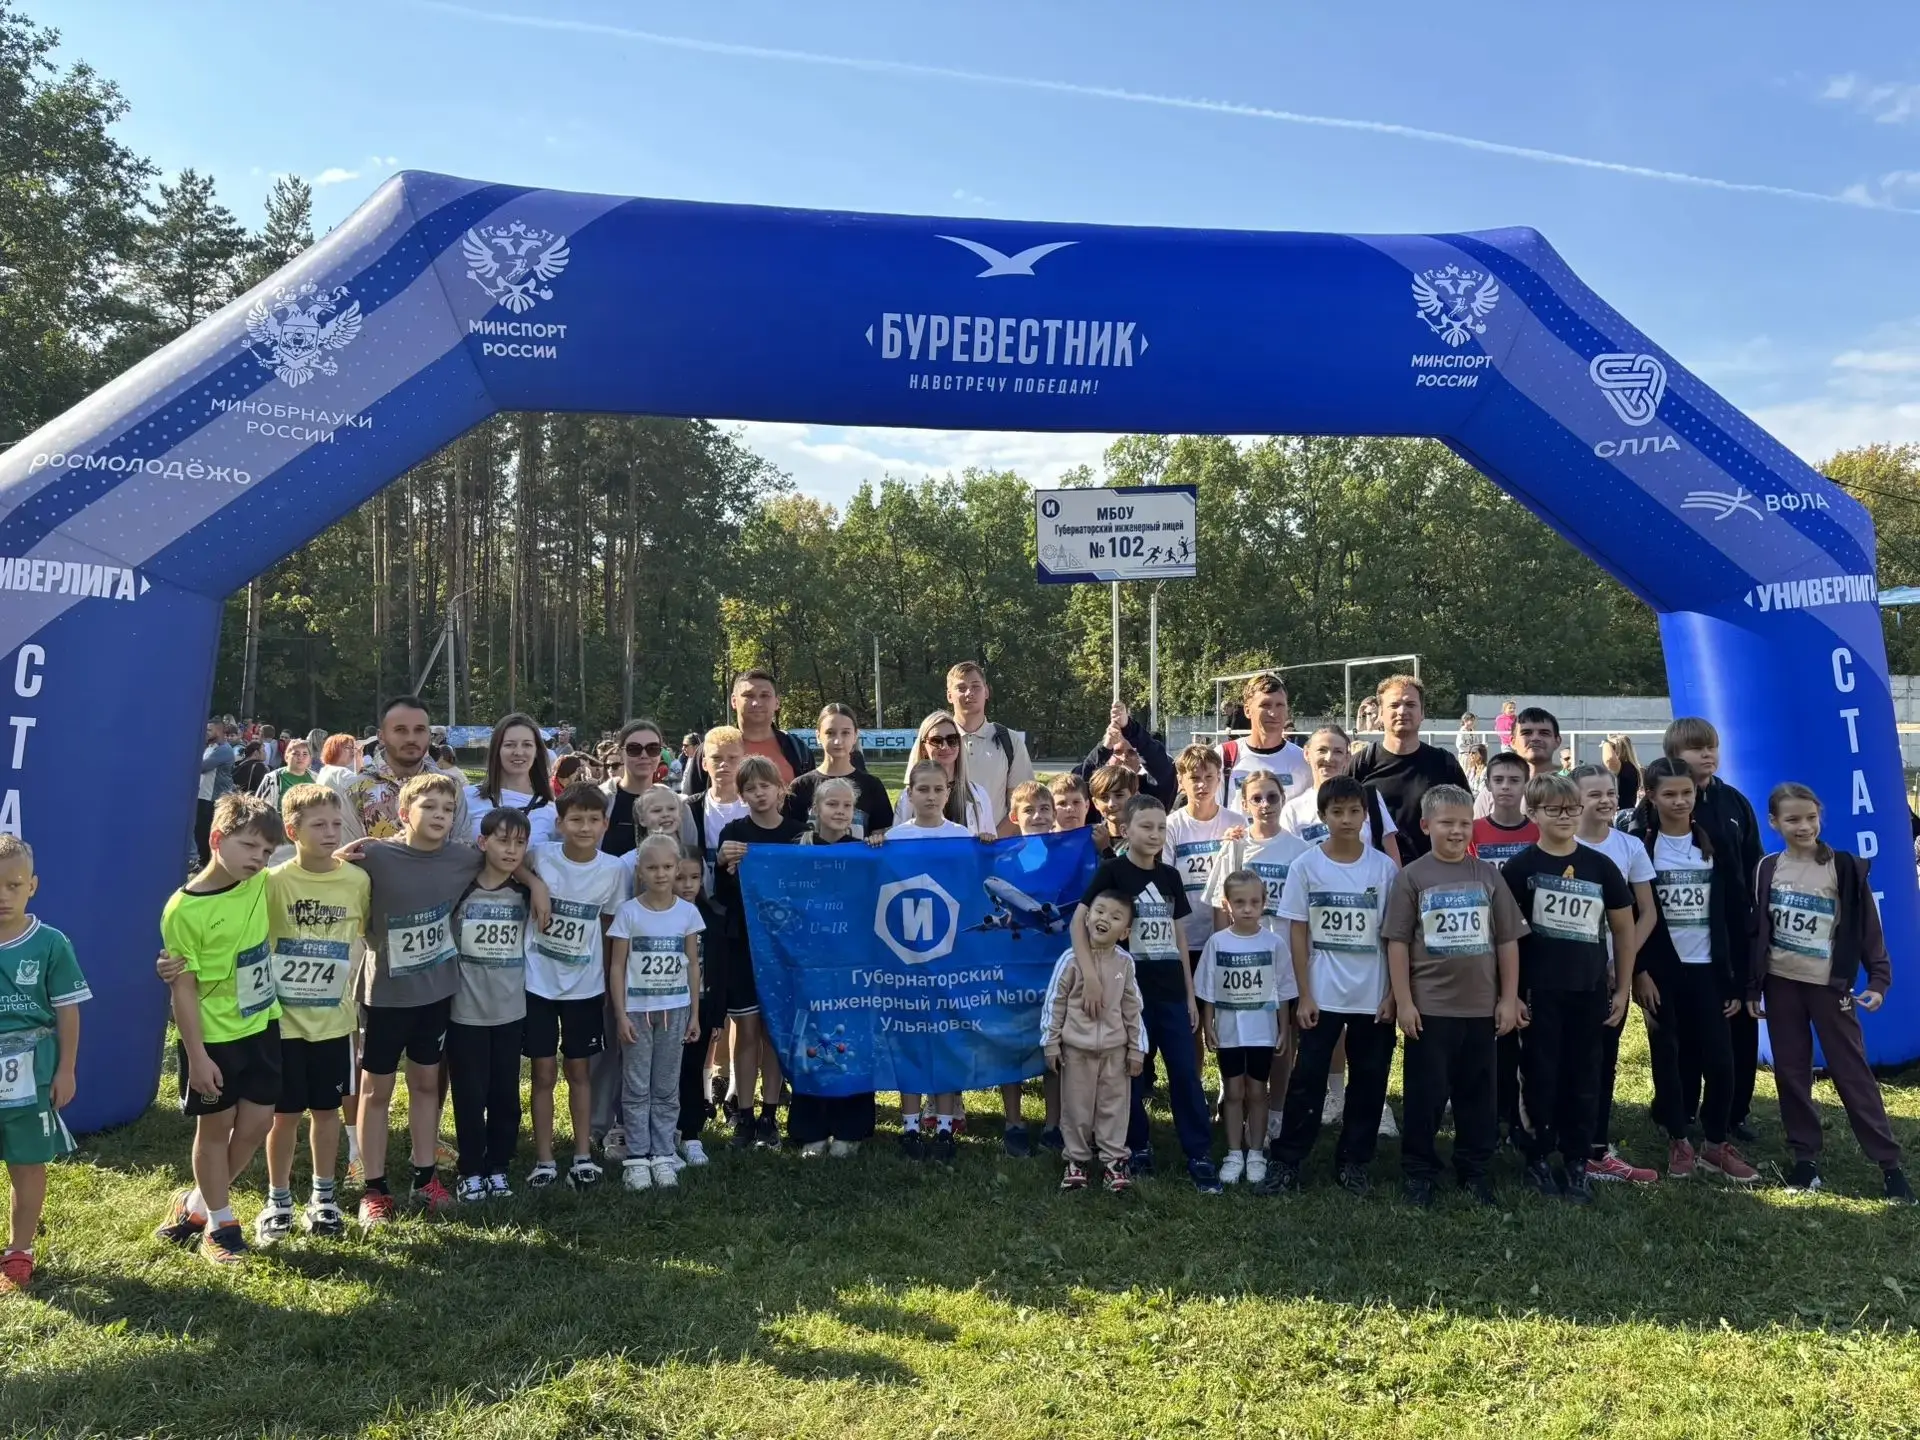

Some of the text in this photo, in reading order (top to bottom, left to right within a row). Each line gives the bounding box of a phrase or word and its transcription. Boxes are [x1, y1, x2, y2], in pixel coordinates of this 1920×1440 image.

[469, 319, 567, 340] МИНСПОРТ
[881, 312, 1136, 367] БУРЕВЕСТНИК
[482, 342, 557, 359] РОССИИ
[1411, 354, 1492, 369] МИНСПОРТ
[910, 374, 1099, 394] НАВСТРЕЧУ ПОБЕДАМ!
[1416, 374, 1478, 388] РОССИИ
[211, 399, 372, 429] МИНОБРНАУКИ
[247, 421, 334, 443] РОССИИ
[28, 452, 251, 485] росмолодёжь
[1765, 492, 1830, 512] ВФЛА
[1097, 506, 1134, 521] МБОУ
[1055, 520, 1184, 537] Губернаторский инженерный лицей
[1090, 536, 1144, 559] № 102
[1756, 575, 1877, 612] УНИВЕРЛИГА
[875, 736, 905, 747] ВСЯ
[1544, 893, 1592, 919] 2107
[1659, 887, 1704, 907] 2428
[542, 917, 585, 943] 2281
[902, 897, 933, 941] И
[1321, 910, 1366, 932] 2913
[1435, 911, 1480, 933] 2376
[402, 922, 444, 952] 2196
[474, 923, 518, 945] 2853
[280, 960, 336, 984] 2274
[640, 955, 682, 975] 2328
[852, 965, 1003, 989] Губернаторский
[1223, 969, 1263, 989] 2084
[810, 994, 930, 1011] инженерный
[936, 990, 991, 1010] лицей
[880, 1016, 982, 1033] Ульяновск
